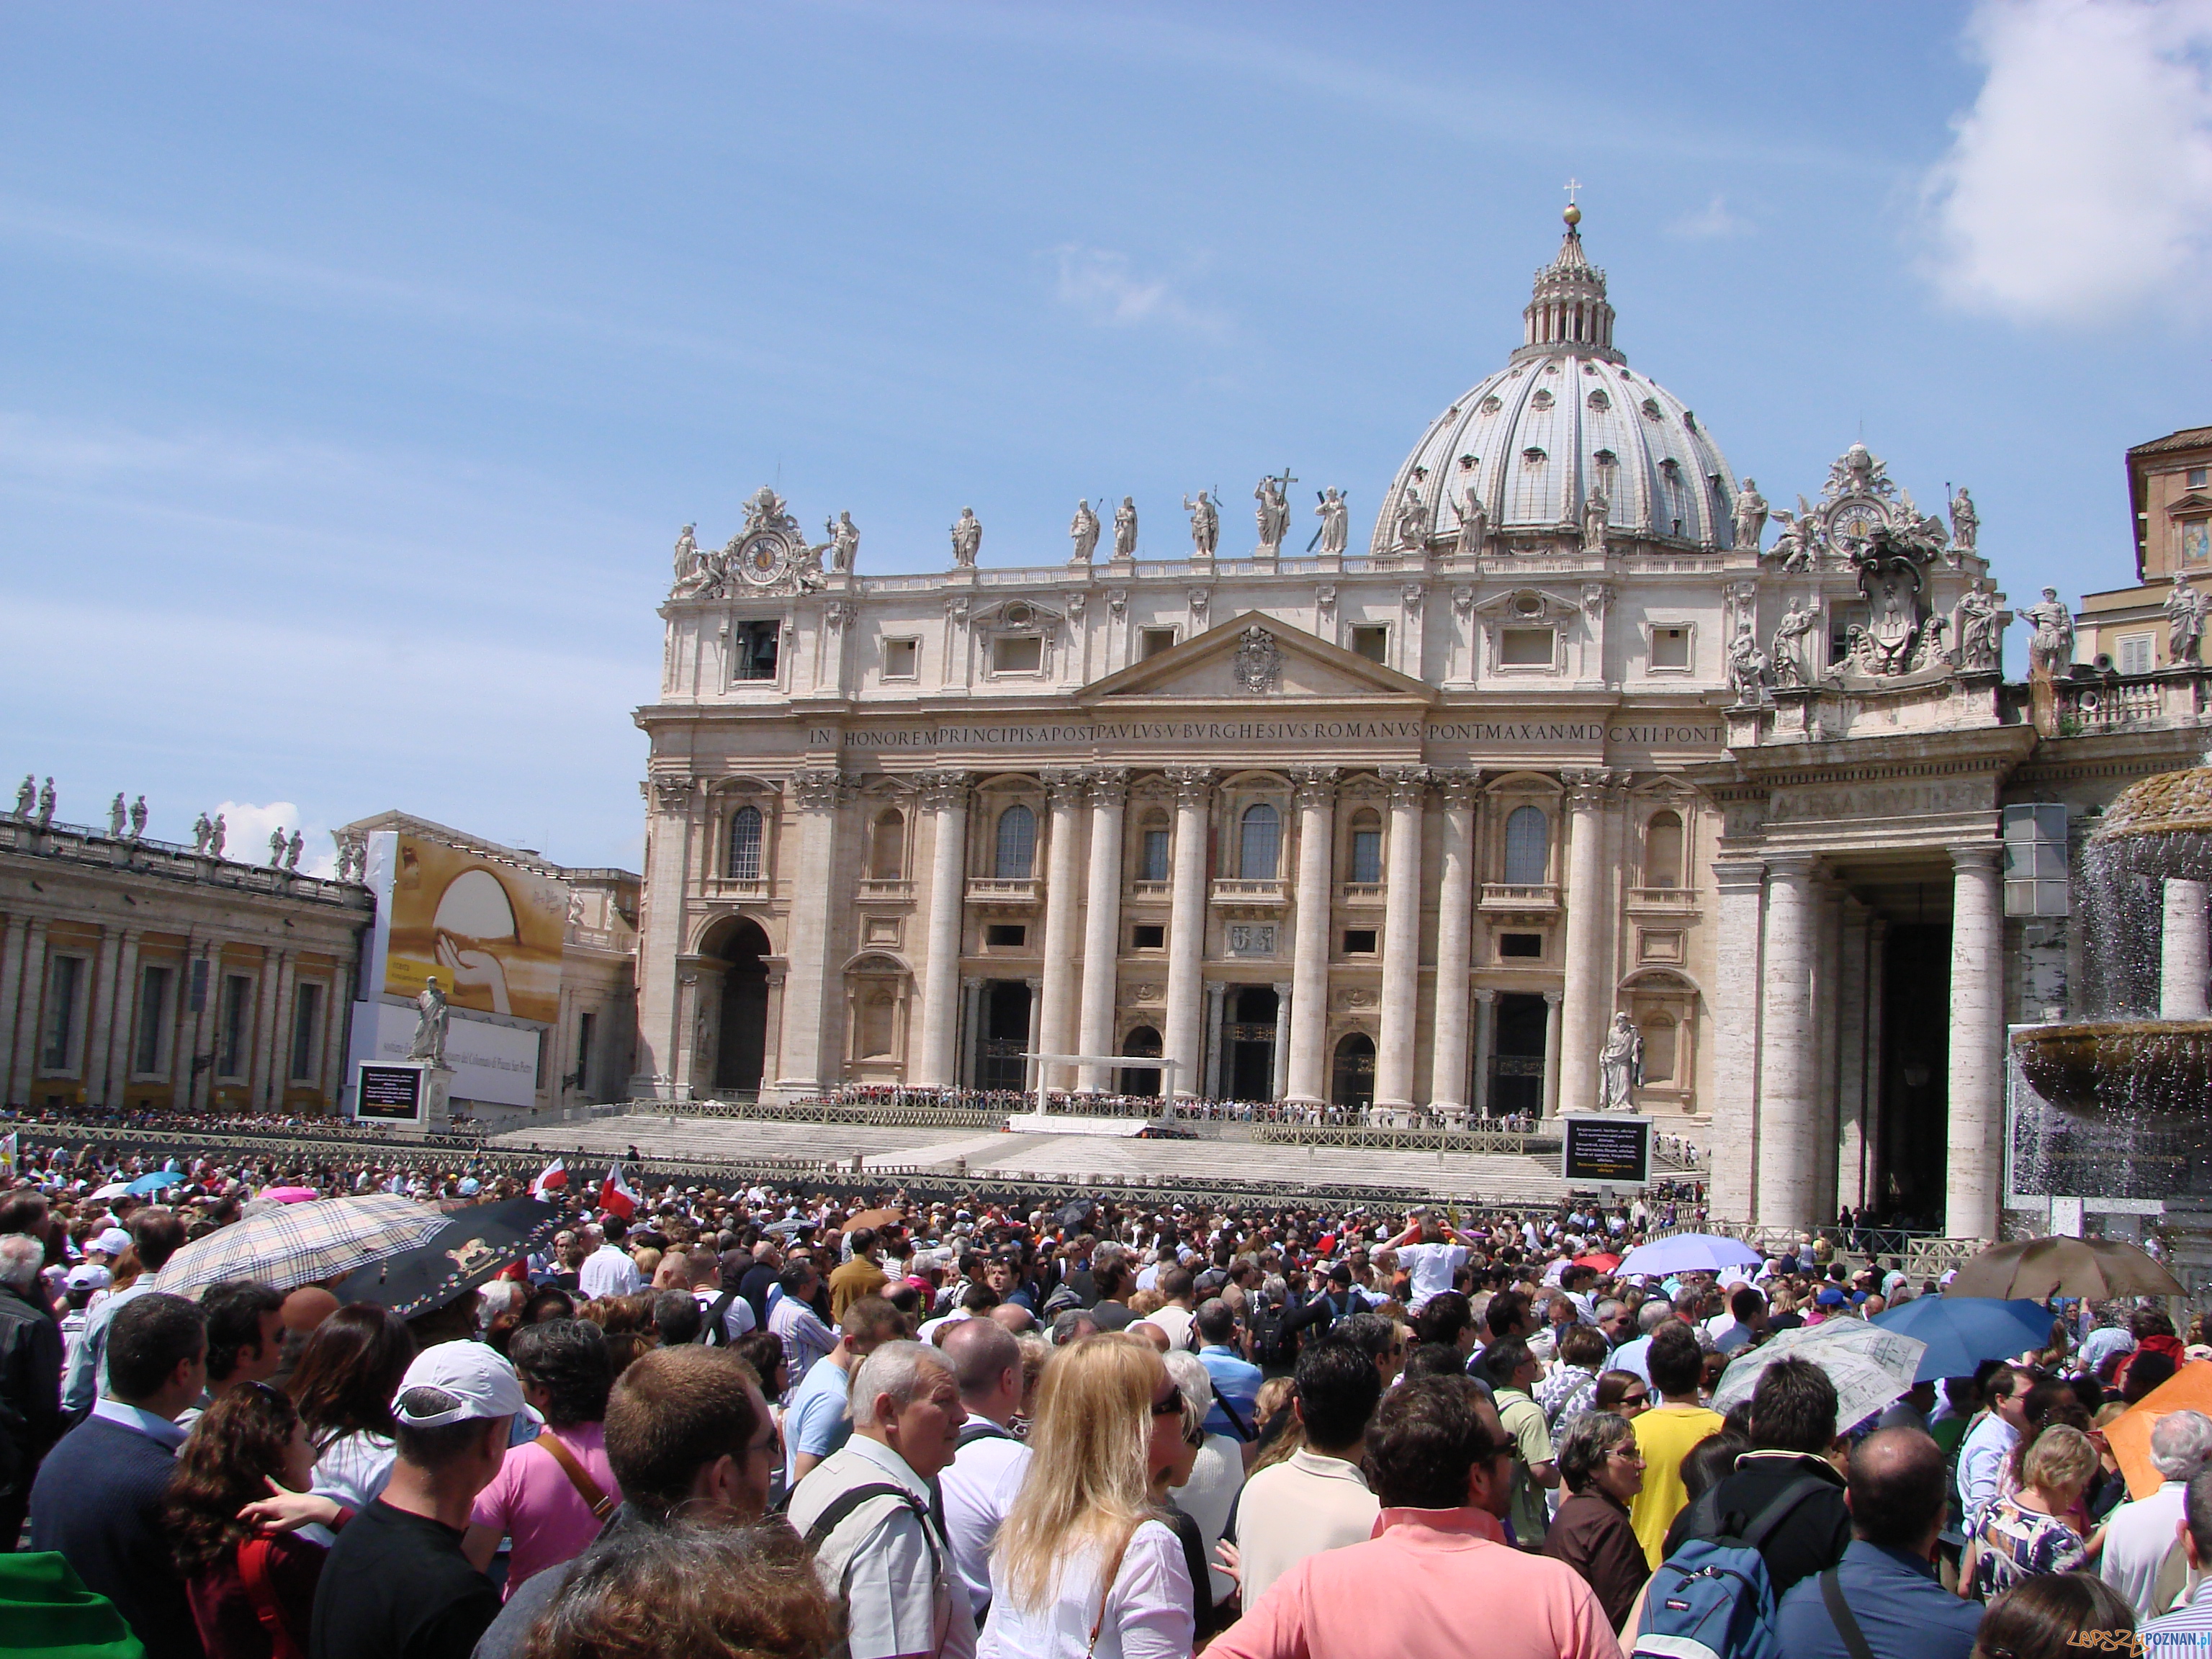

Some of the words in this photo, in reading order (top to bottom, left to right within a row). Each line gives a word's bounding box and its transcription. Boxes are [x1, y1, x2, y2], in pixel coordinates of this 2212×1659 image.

[810, 729, 831, 744] IN
[845, 732, 938, 746] HONOREM
[939, 727, 1033, 743] PRINCIPIS
[1097, 724, 1162, 739] PAVLVS
[1183, 723, 1308, 739] BVRGHESIVS
[1314, 722, 1420, 739] ROMANVS
